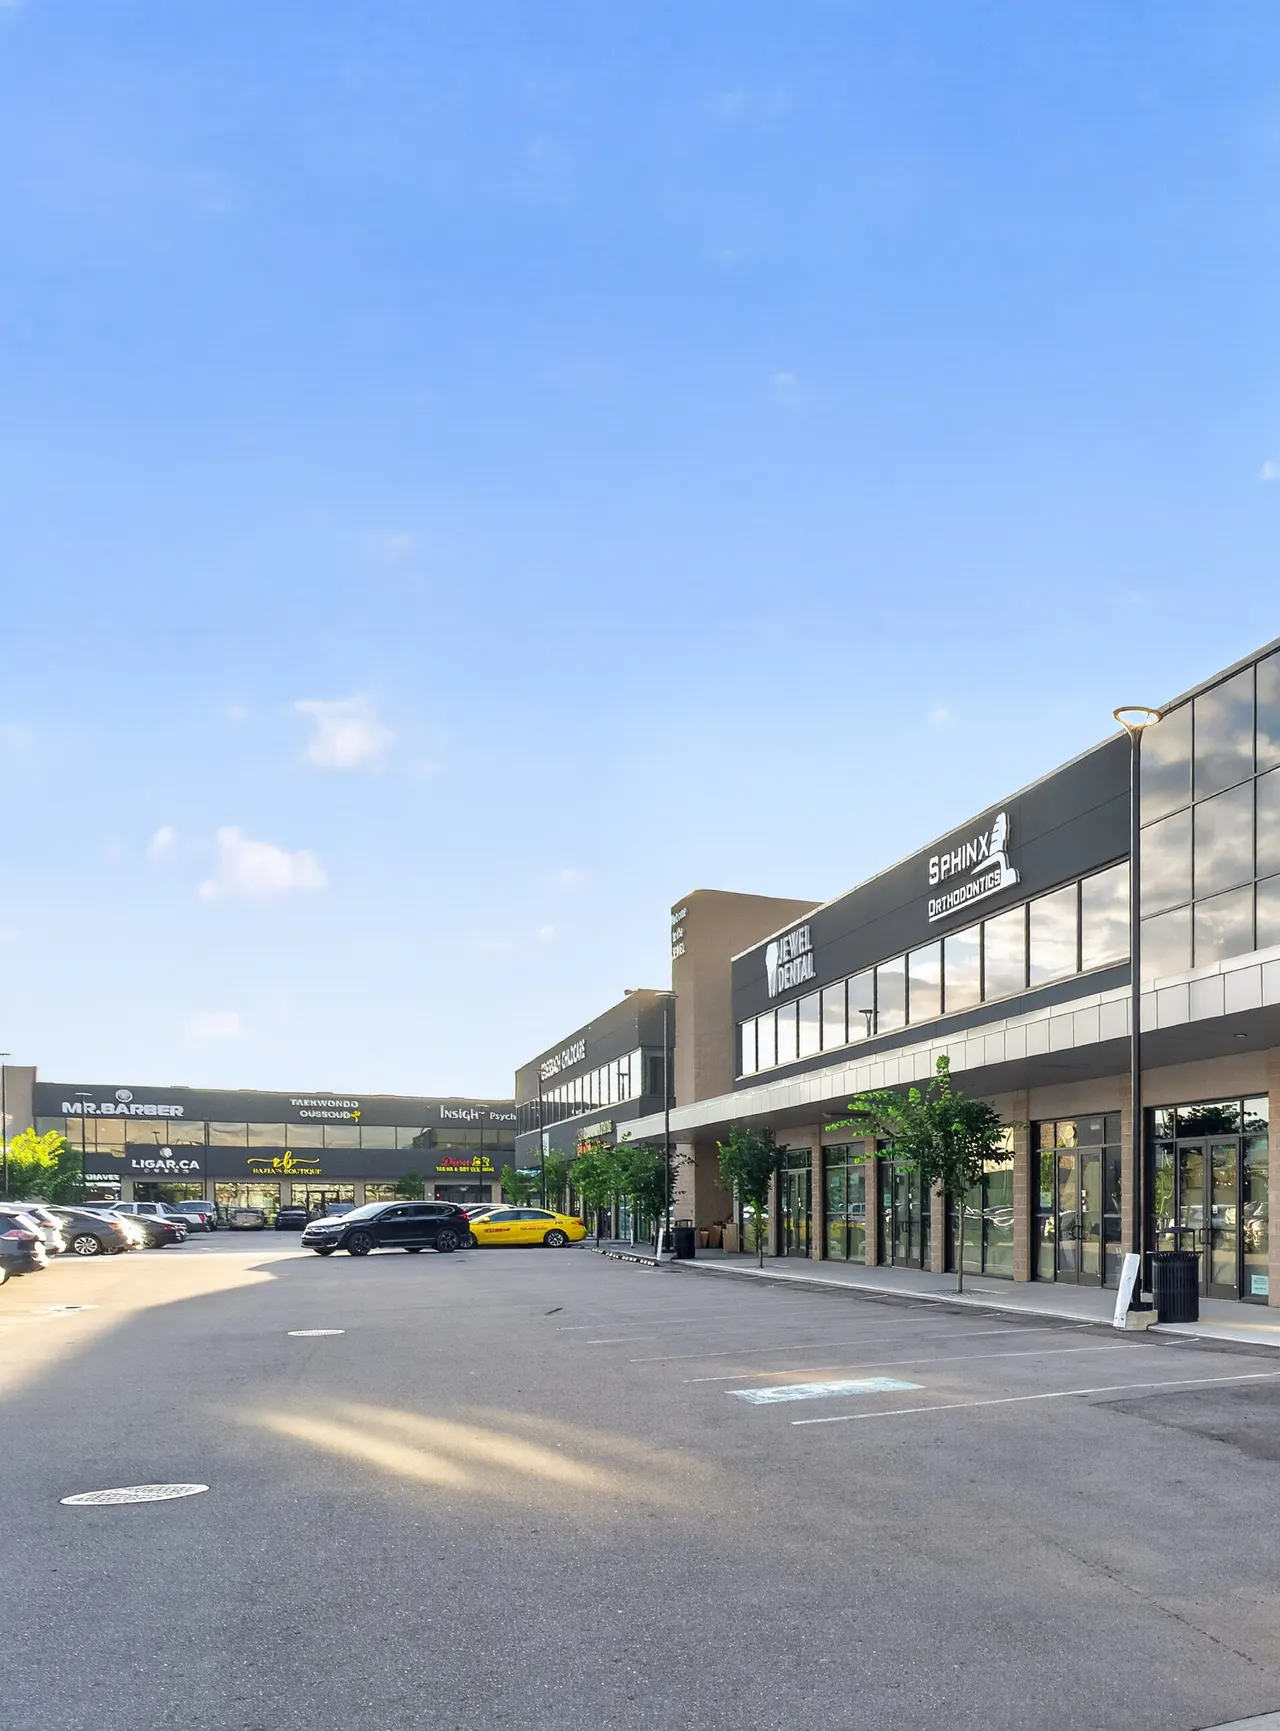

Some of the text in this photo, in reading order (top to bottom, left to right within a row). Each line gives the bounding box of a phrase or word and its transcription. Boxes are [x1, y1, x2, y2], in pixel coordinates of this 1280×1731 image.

[928, 831, 989, 885] SPHINX
[928, 869, 1001, 917] ORTHODONTICS
[778, 925, 813, 965] JEWEL
[778, 952, 816, 993] DENTAL
[61, 1101, 184, 1117] MR.BARBER
[290, 1098, 359, 1108] TAEKWONDO
[131, 1159, 200, 1170] LIGAR.CA
